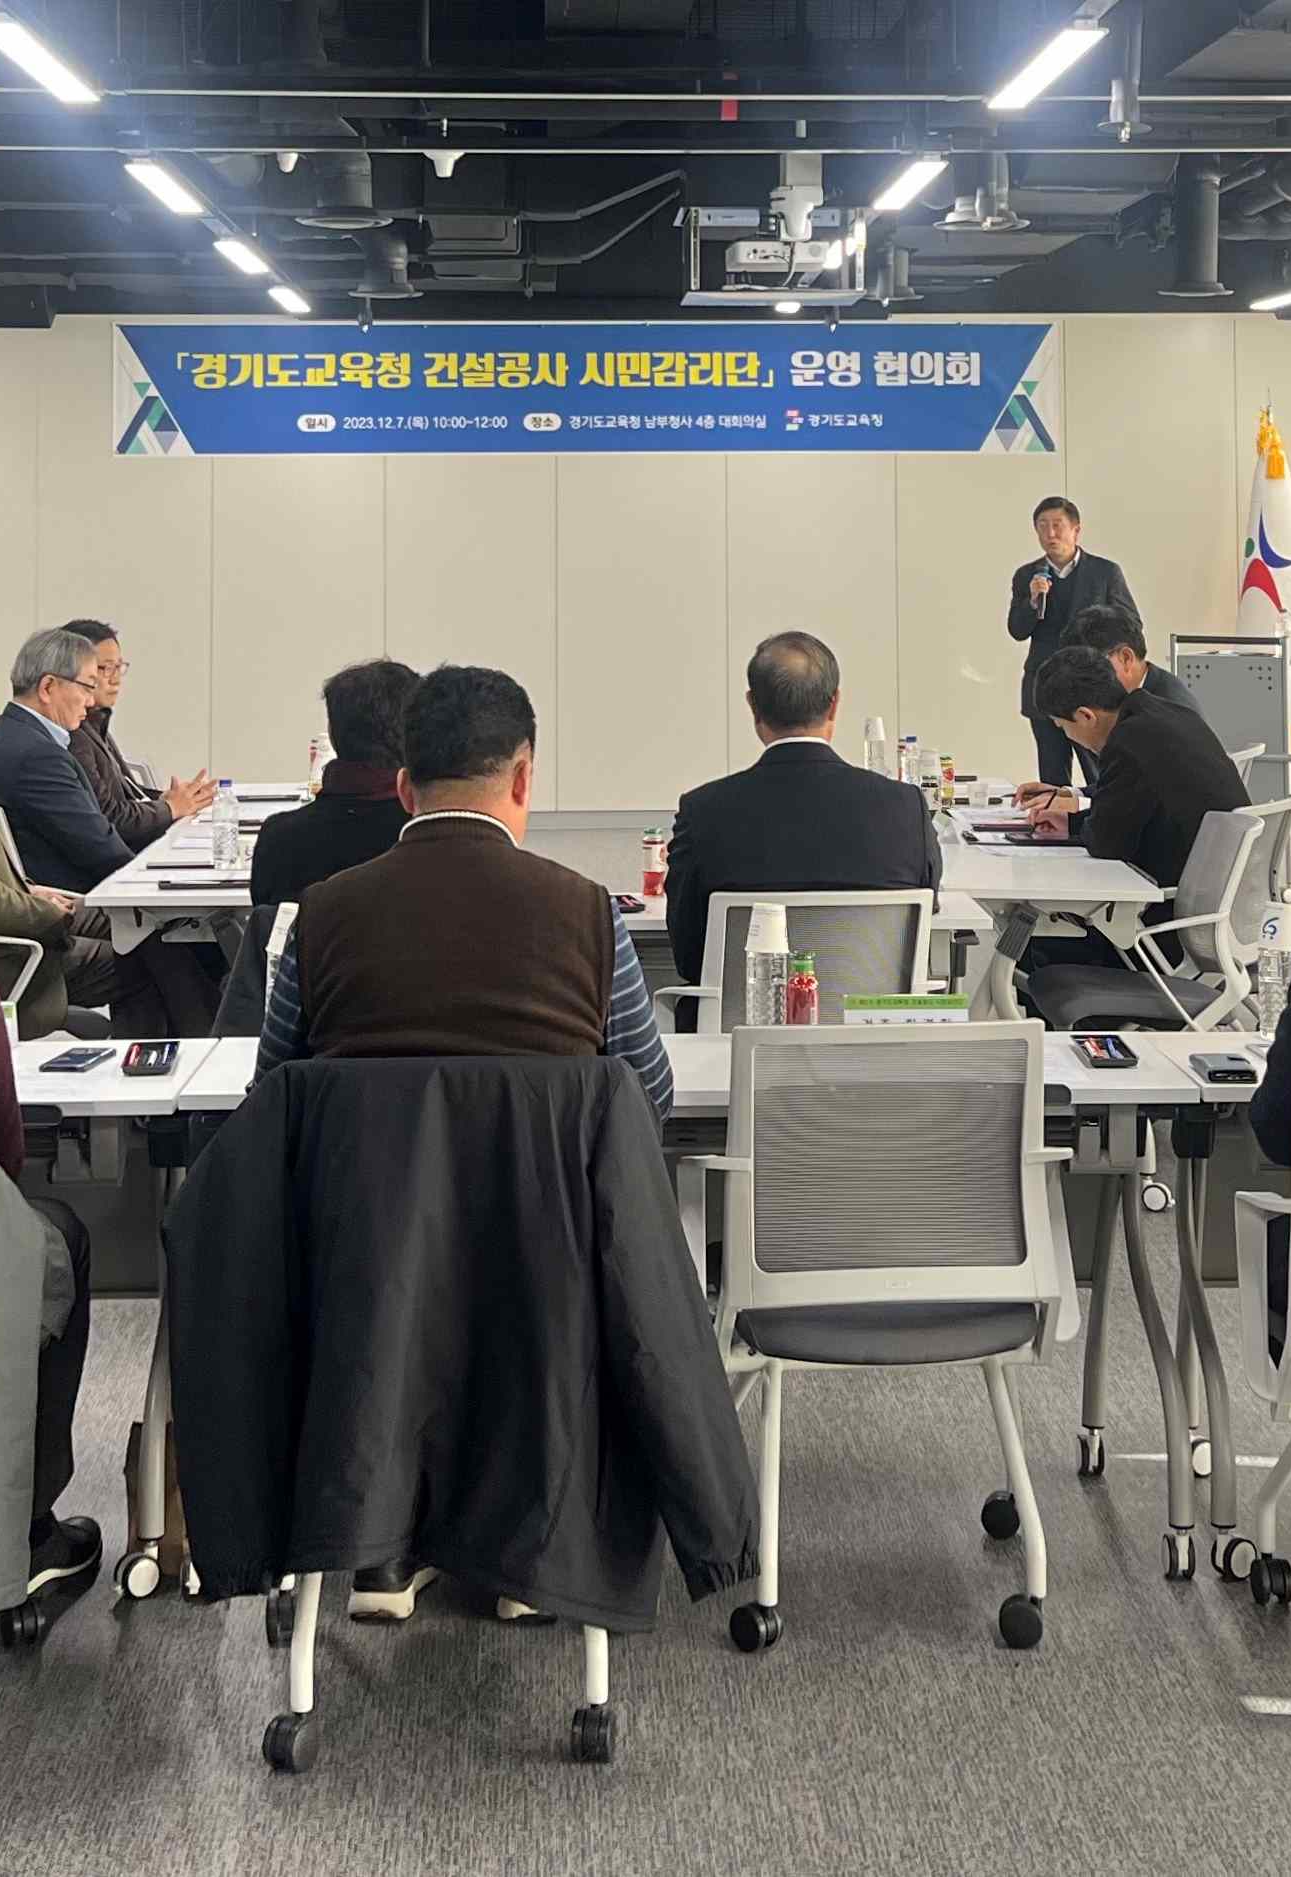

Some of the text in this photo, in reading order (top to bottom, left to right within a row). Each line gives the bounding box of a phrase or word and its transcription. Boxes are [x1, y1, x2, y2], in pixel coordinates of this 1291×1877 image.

[177, 351, 981, 389] 「경기도교육청 건설공사 시민감리단」 운영 협의회
[305, 418, 328, 429] 일시
[531, 416, 554, 428] 장소
[569, 415, 641, 430] 경기도교육청
[644, 414, 692, 430] 남부청사
[695, 414, 715, 430] 4층
[719, 414, 767, 429] 대회의실
[808, 413, 883, 428] 경기도교육청
